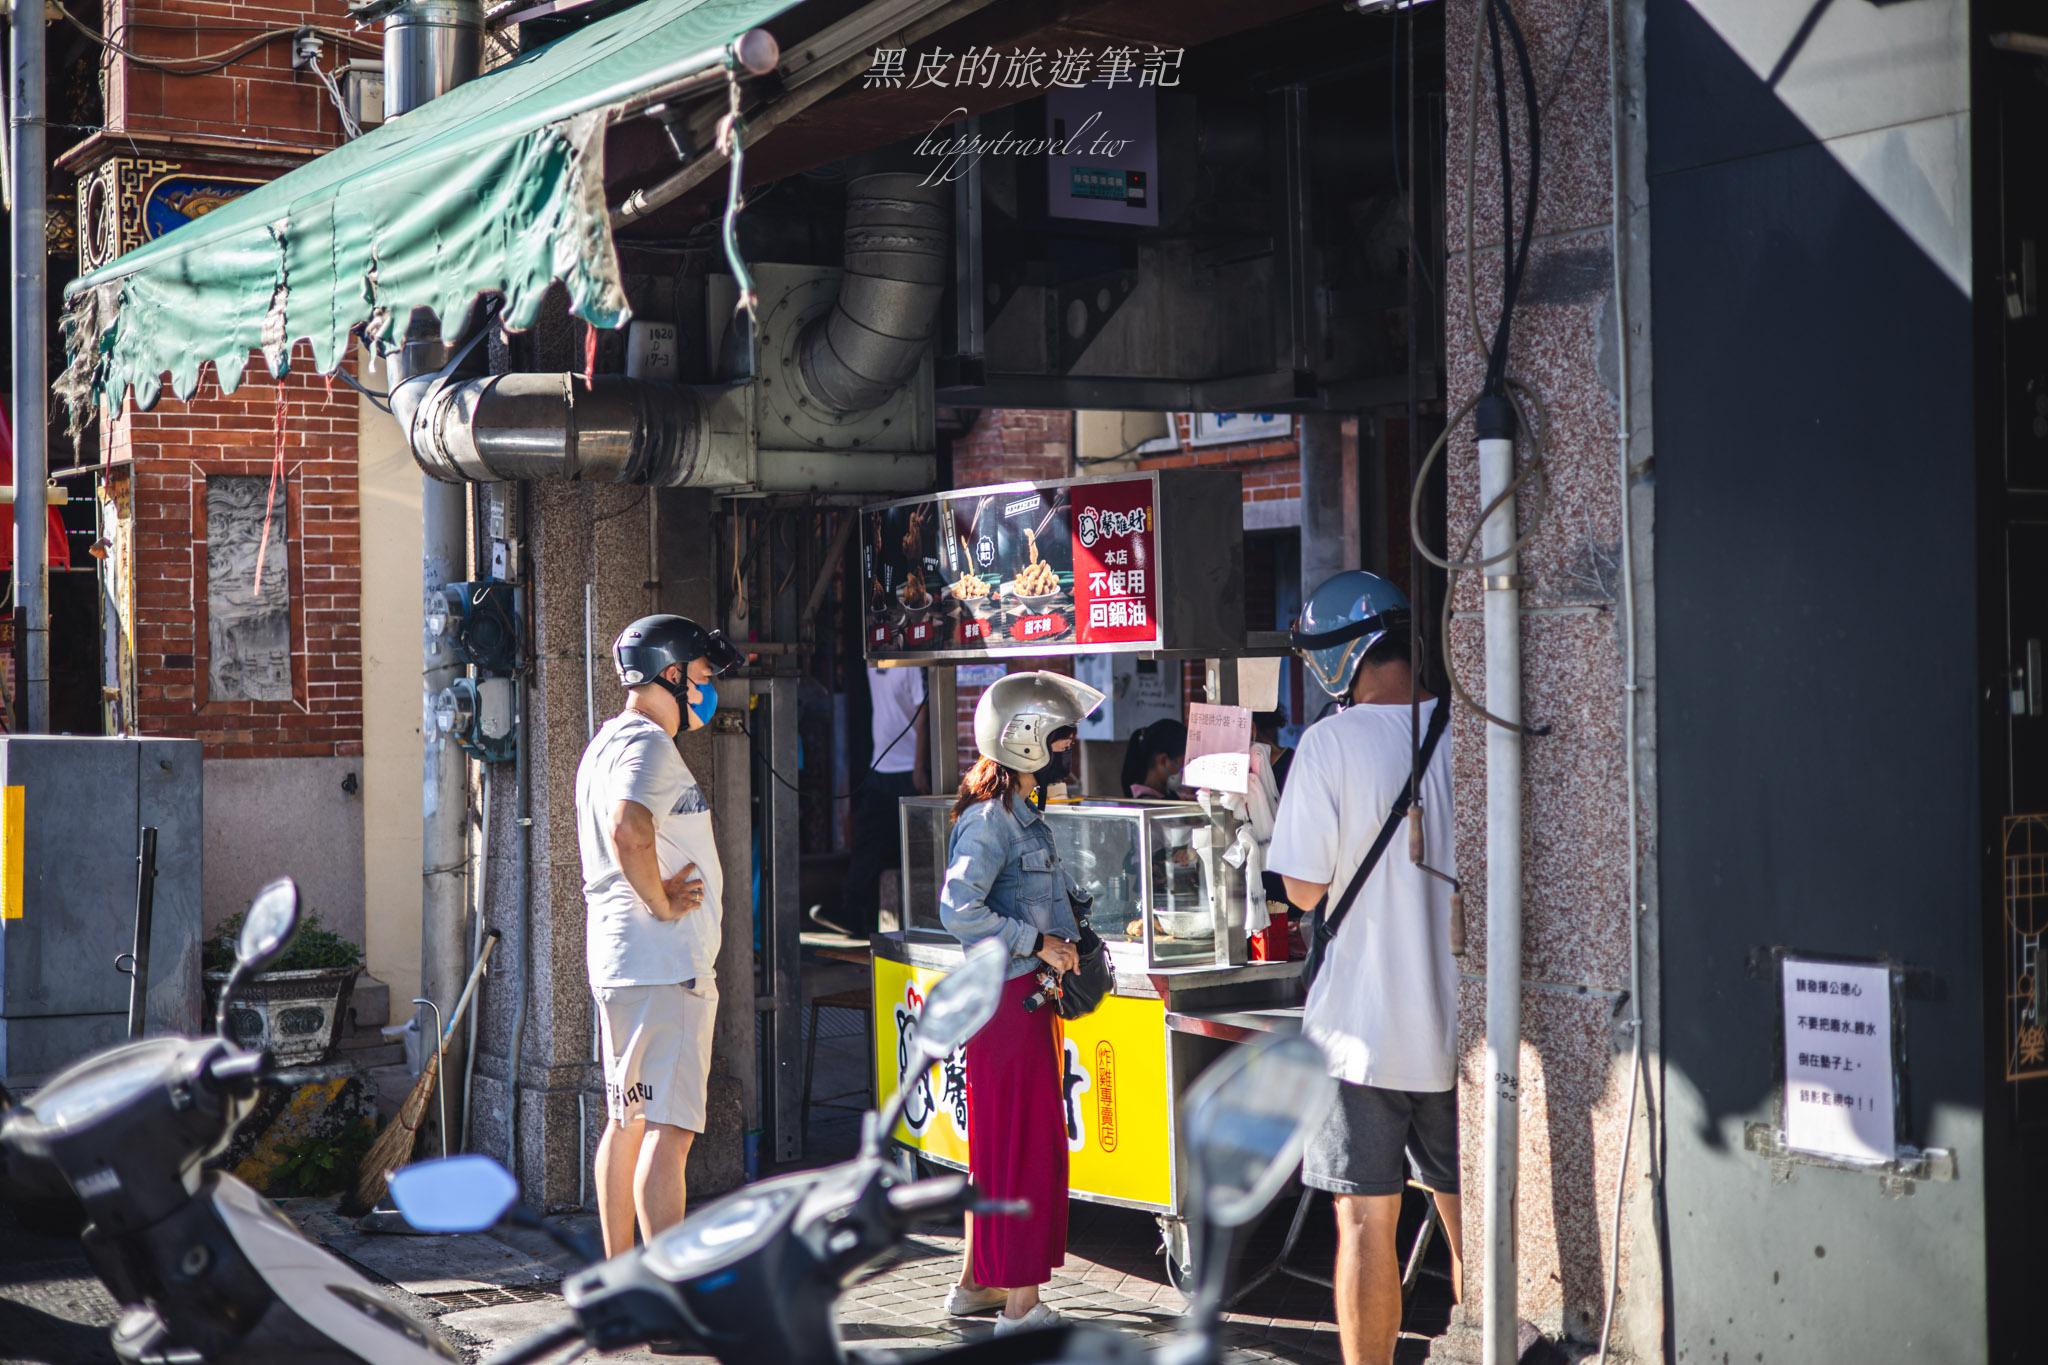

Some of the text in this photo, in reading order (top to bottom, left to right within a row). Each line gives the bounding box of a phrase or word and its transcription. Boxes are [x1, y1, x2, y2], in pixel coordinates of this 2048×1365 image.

[1104, 550, 1128, 565] 本店
[1089, 570, 1145, 596] 不使用
[1090, 600, 1147, 628] 回鍋油
[1024, 617, 1052, 635] 甜不辣
[1796, 978, 1862, 997] 請發揮公德心
[1098, 1047, 1114, 1146] 炸雞專賣店
